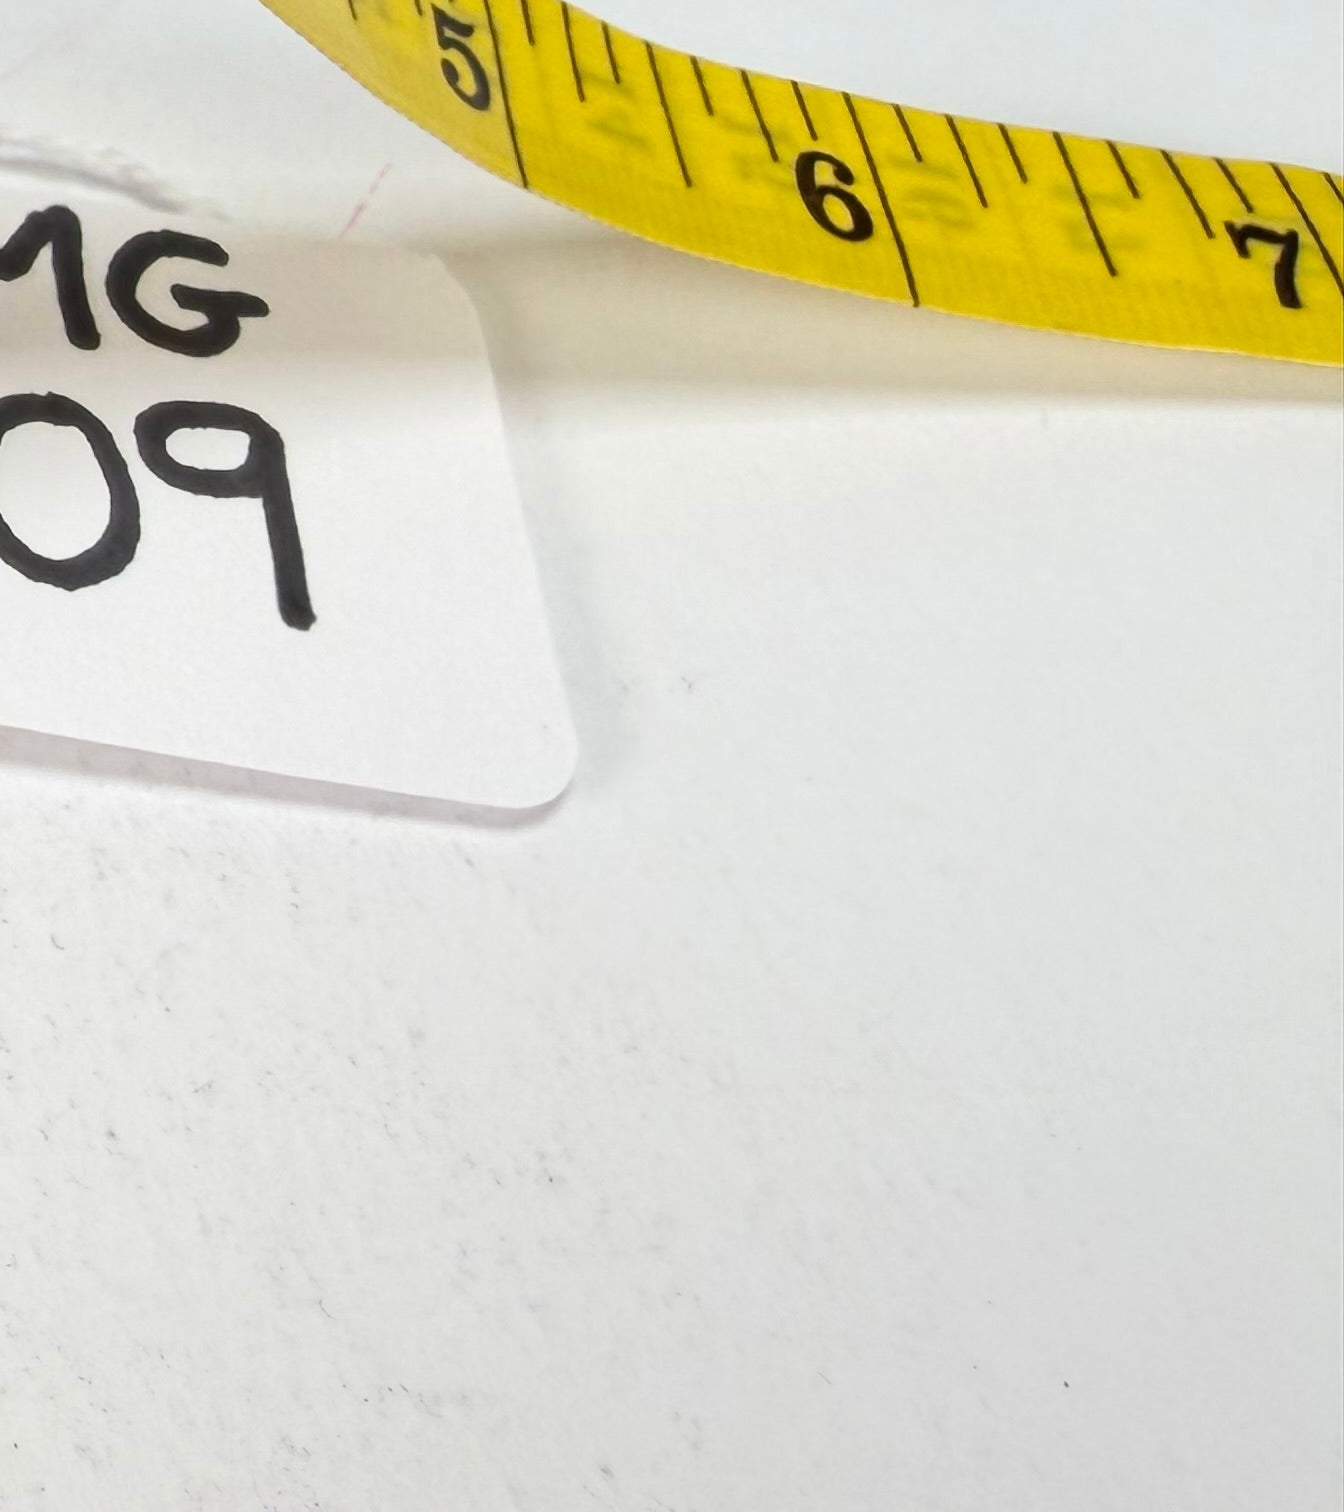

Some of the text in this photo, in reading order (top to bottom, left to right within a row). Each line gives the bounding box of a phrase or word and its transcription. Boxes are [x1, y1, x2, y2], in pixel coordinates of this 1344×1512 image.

[430, 1, 491, 112] 5
[794, 151, 874, 242] 6
[1223, 220, 1303, 309] 7
